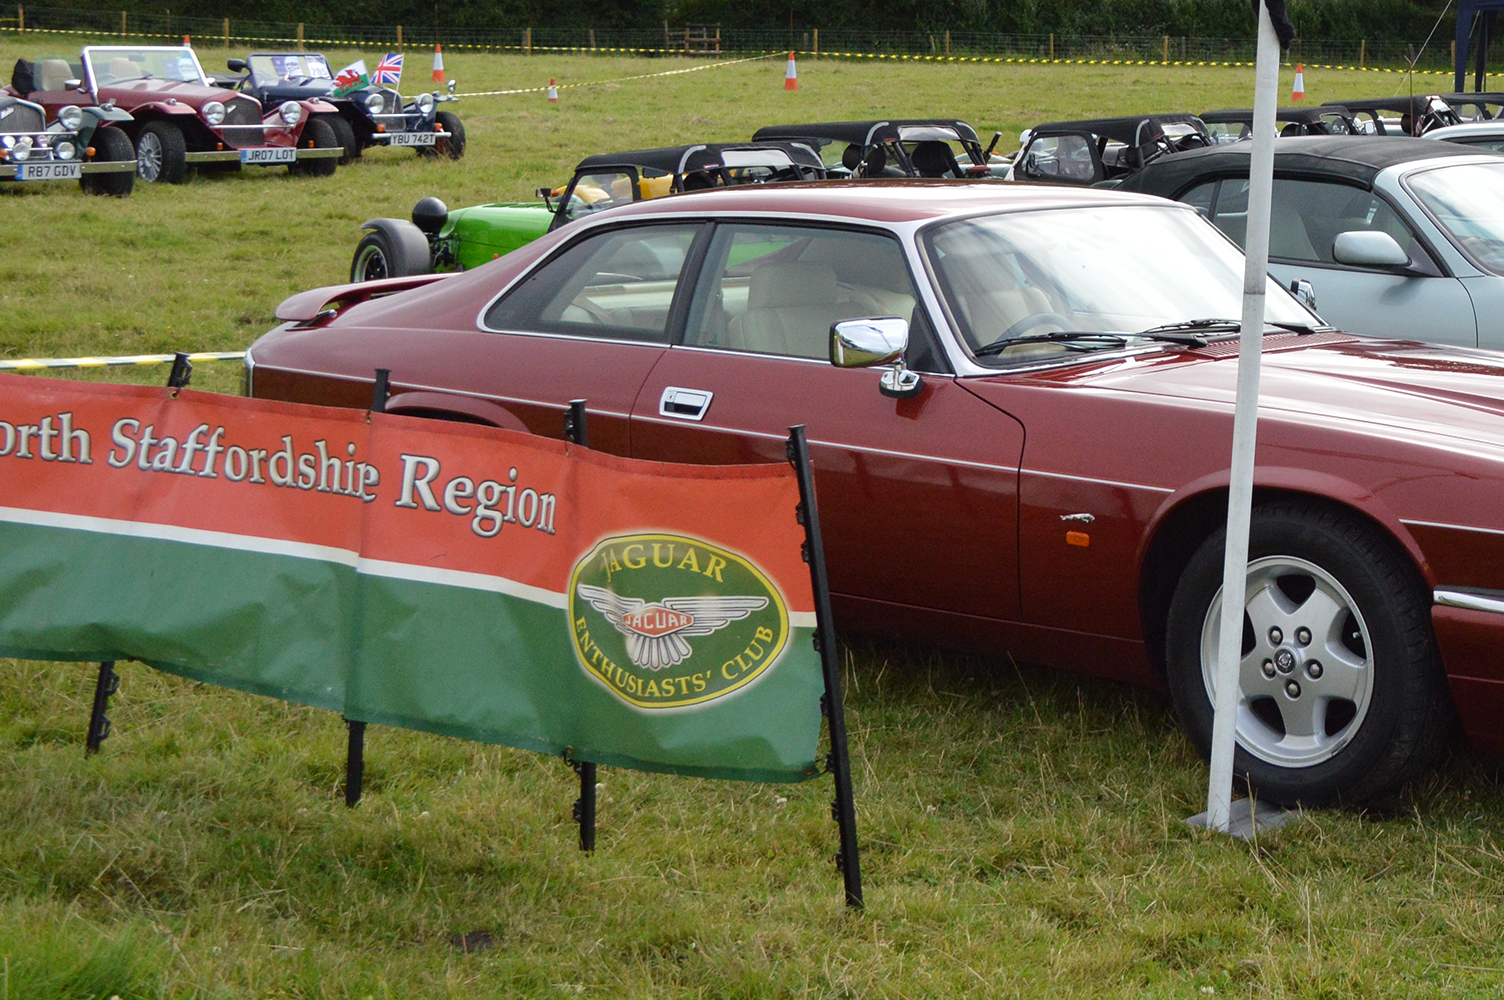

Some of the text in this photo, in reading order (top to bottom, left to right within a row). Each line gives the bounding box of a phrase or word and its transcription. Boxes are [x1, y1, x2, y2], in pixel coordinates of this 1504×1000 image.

[392, 134, 435, 144] YBU 742T
[276, 150, 294, 160] LOT
[28, 165, 77, 177] R87 GDV
[0, 412, 93, 466] orth
[395, 453, 557, 539] Region
[601, 543, 727, 583] JAGUAR
[625, 614, 688, 629] JAGUAR
[576, 616, 774, 697] ENTHUSIASTS' CLUB
